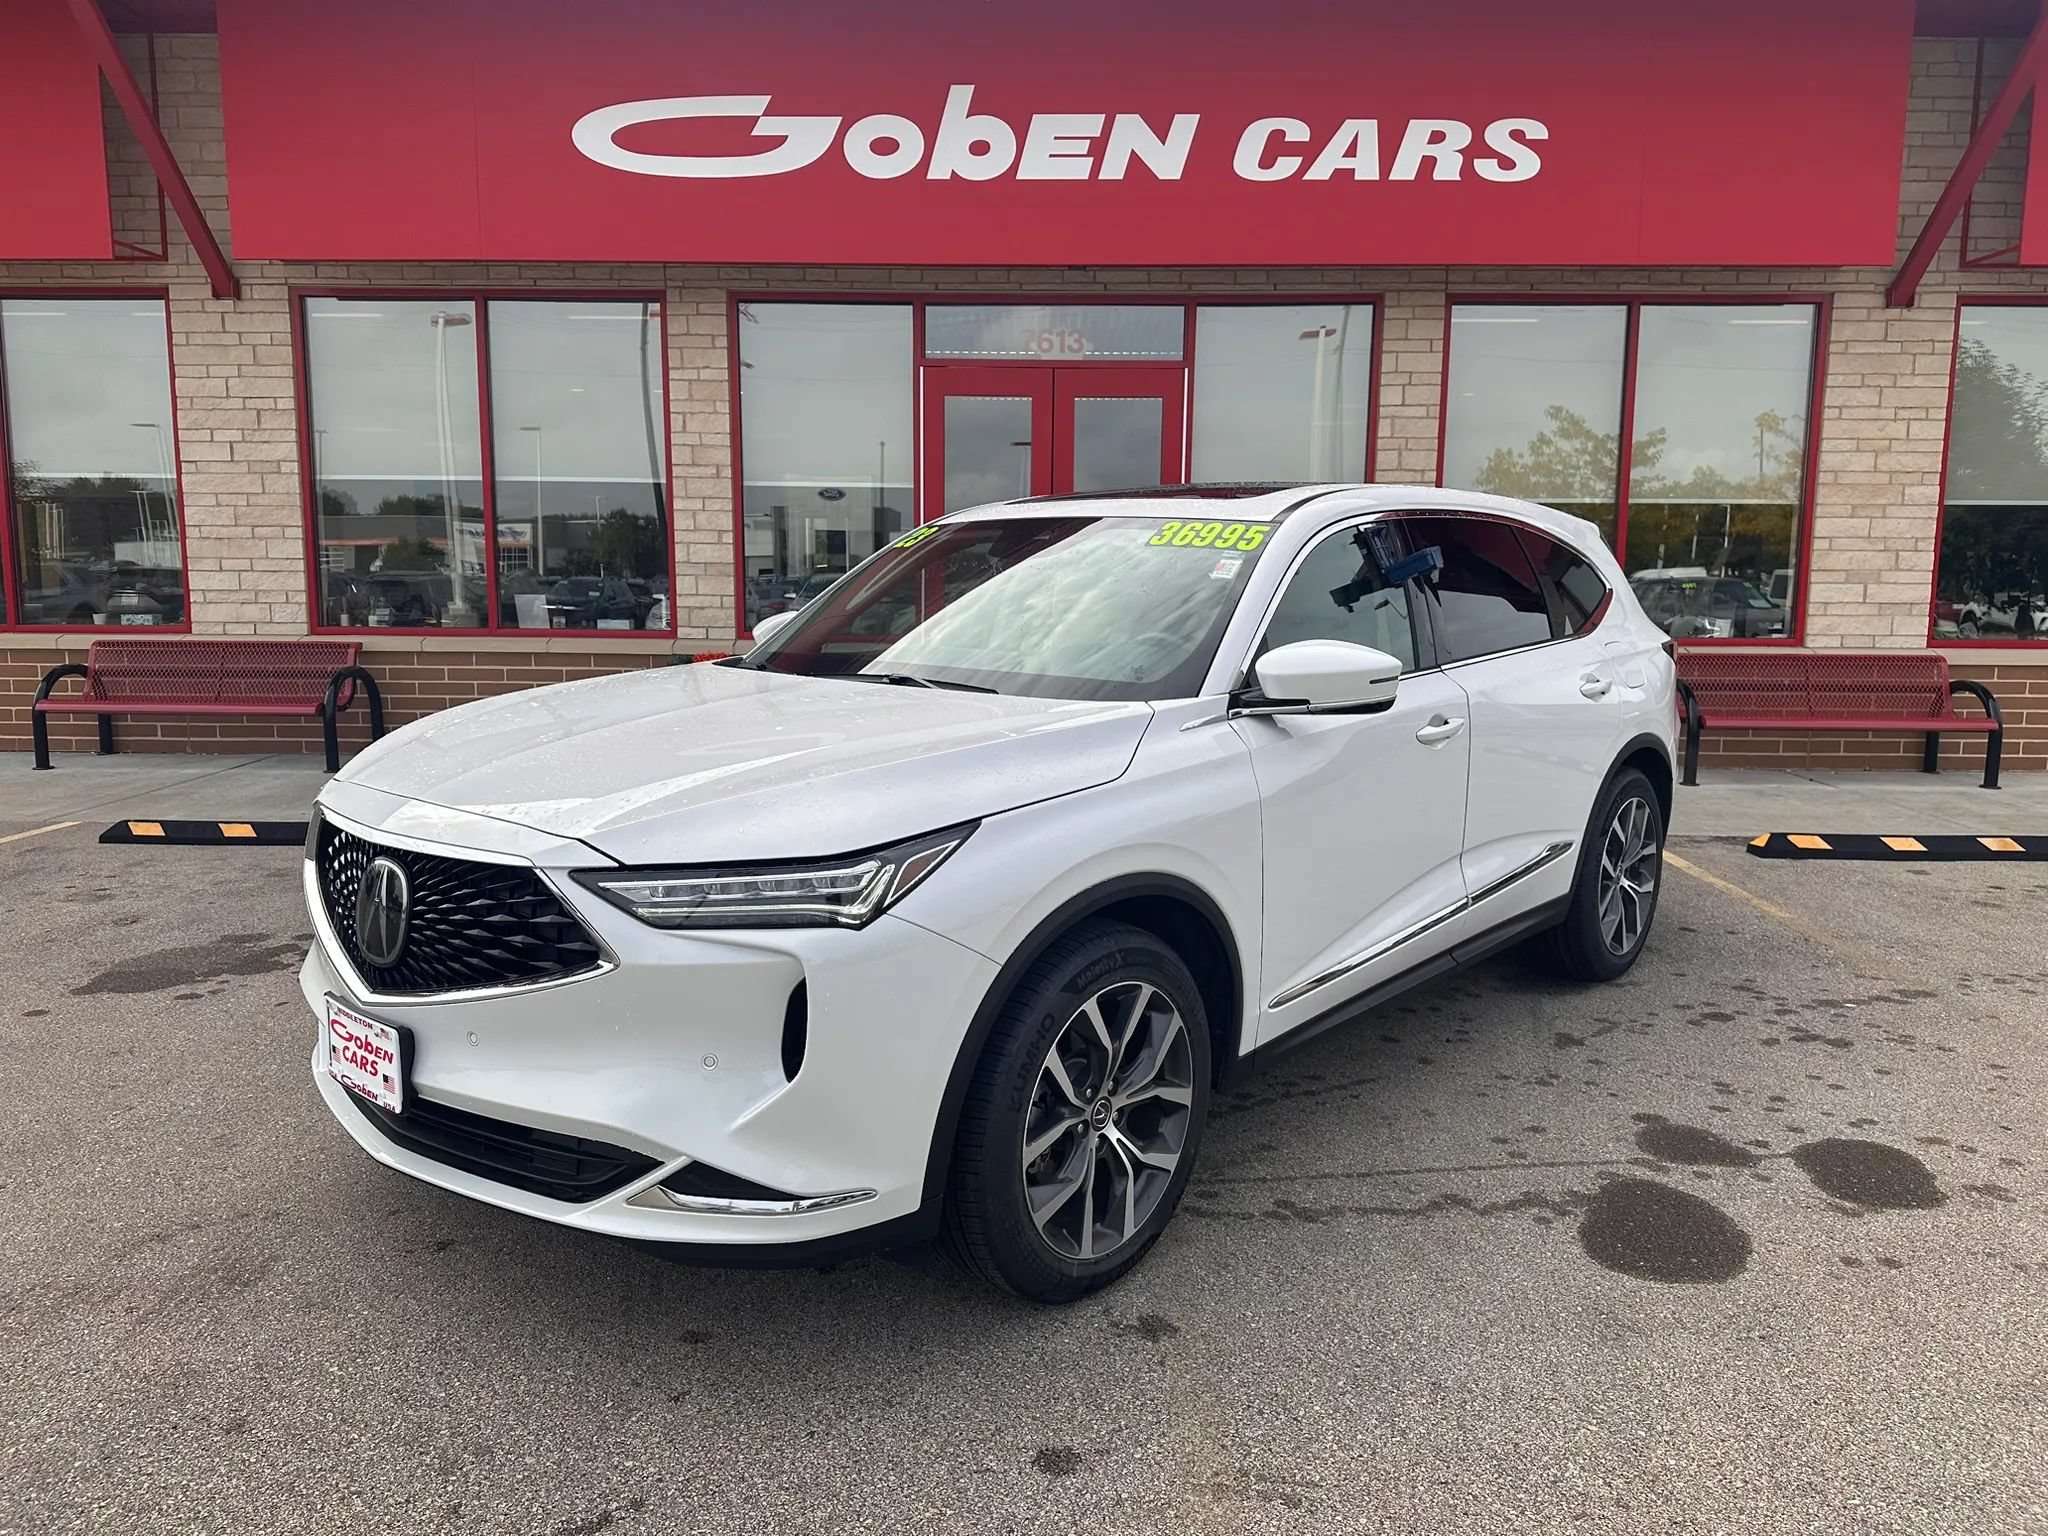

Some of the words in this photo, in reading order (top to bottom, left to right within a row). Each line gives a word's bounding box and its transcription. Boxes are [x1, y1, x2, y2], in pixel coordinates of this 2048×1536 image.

[1232, 116, 1550, 183] CARS
[1021, 328, 1085, 353] 7613
[1150, 521, 1271, 550] 36995
[342, 1045, 379, 1077] CARS
[383, 1101, 396, 1112] USA
